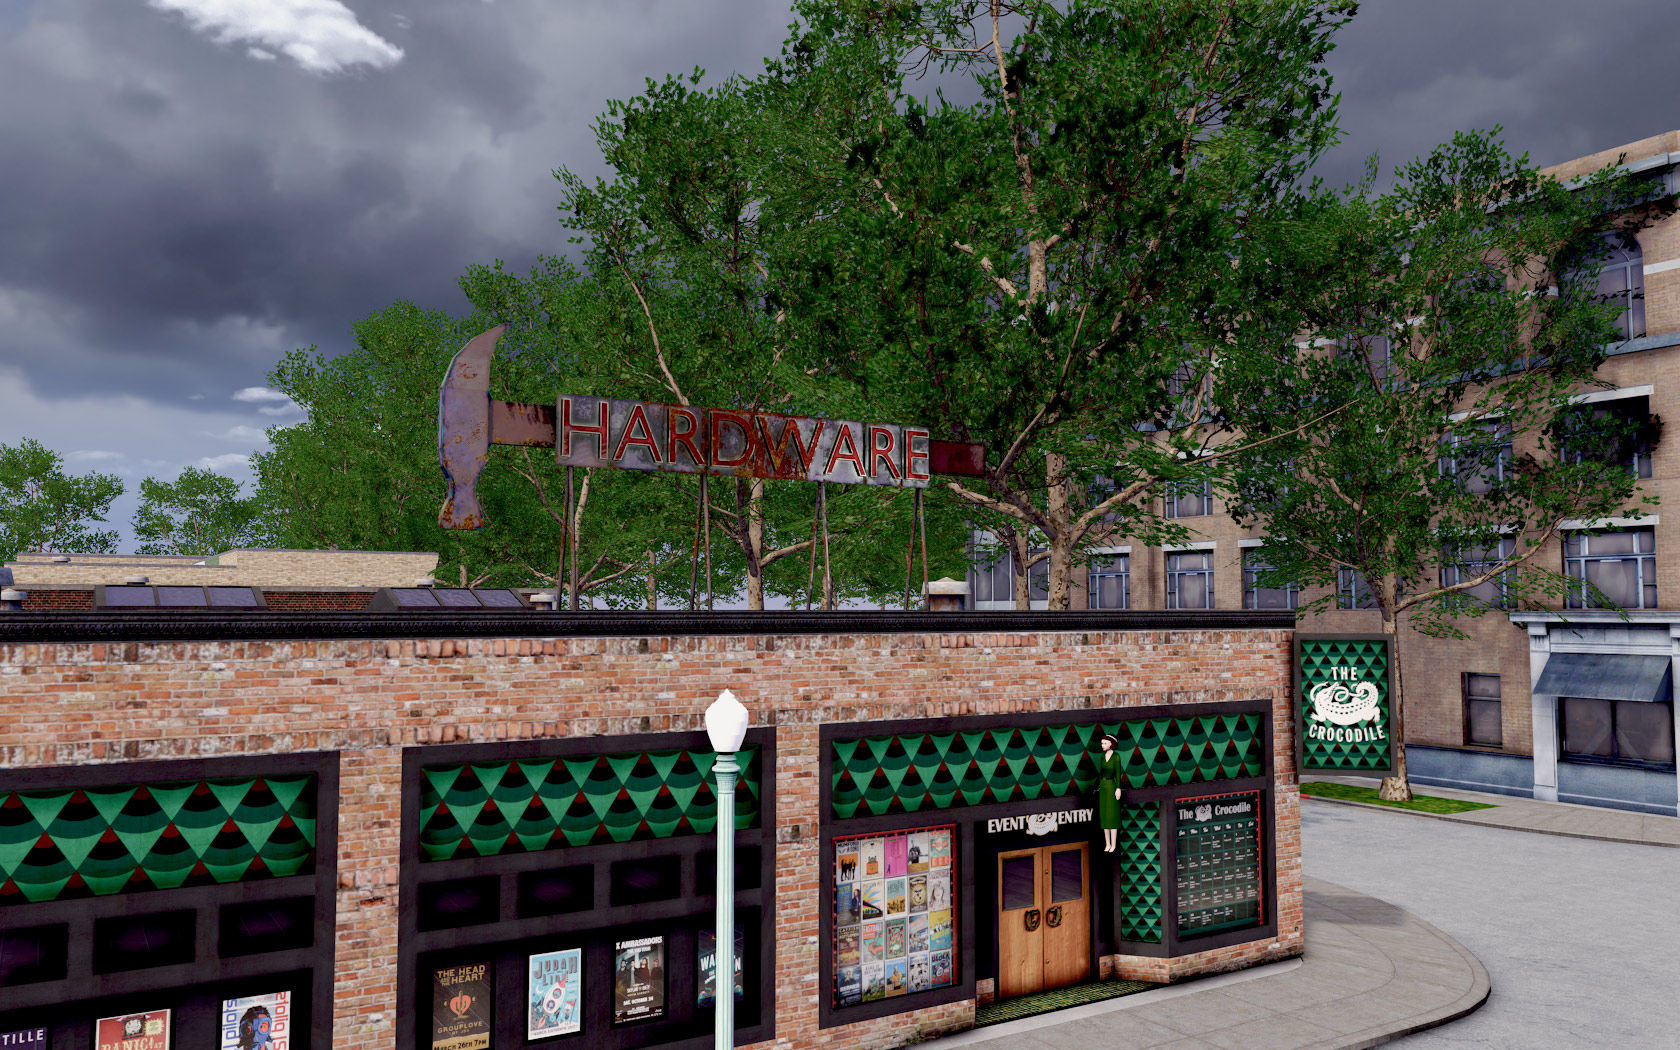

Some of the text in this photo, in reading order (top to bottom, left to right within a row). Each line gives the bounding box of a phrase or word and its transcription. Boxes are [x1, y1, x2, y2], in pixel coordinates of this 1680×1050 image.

[560, 398, 930, 480] HARDWARE
[1331, 666, 1358, 681] THE
[1308, 724, 1386, 743] CROCODILE
[1178, 801, 1252, 821] The Crocodile
[987, 807, 1094, 834] EVENT ENTRY
[621, 935, 663, 949] AMBASSADORS
[437, 965, 486, 979] THE HEAD
[534, 956, 578, 979] JUDAH
[451, 972, 485, 985] HEART
[222, 998, 240, 1040] pilots
[437, 1020, 484, 1034] GROUPLOVE
[2, 1029, 44, 1046] TILLE
